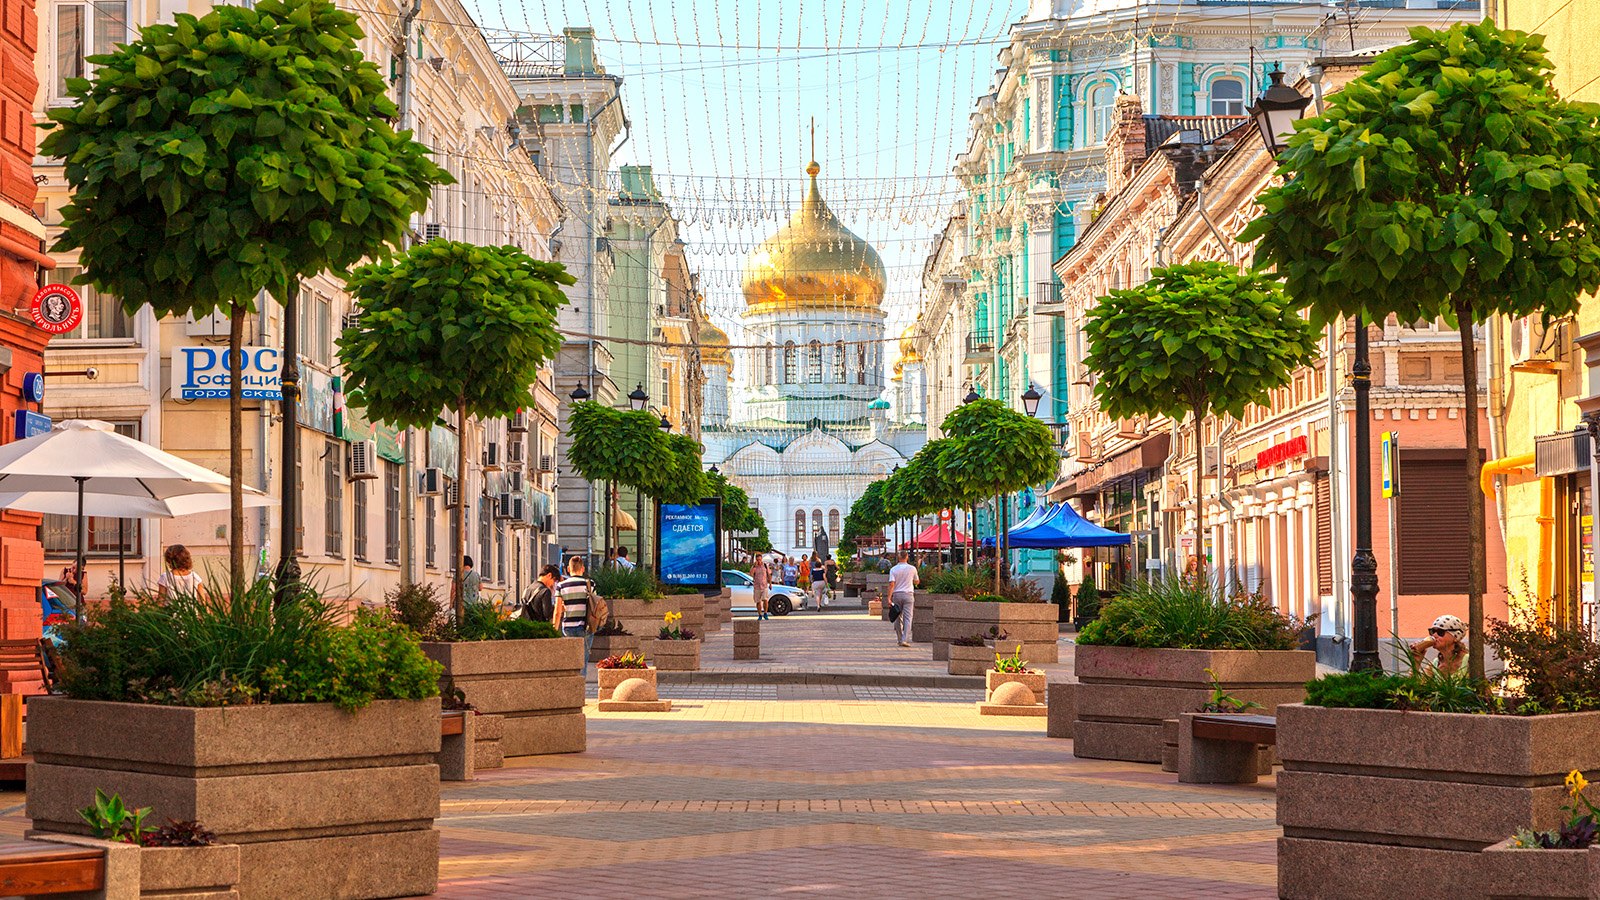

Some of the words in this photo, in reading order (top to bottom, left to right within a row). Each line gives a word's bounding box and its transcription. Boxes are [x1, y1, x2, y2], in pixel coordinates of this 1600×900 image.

[35, 287, 52, 302] САЛОН
[53, 286, 77, 302] КРАСОТЫ
[32, 307, 79, 332] ЦИРЮЛЬНИКЪ
[184, 390, 283, 398] гороская
[672, 524, 704, 533] СДАЕТСЯ
